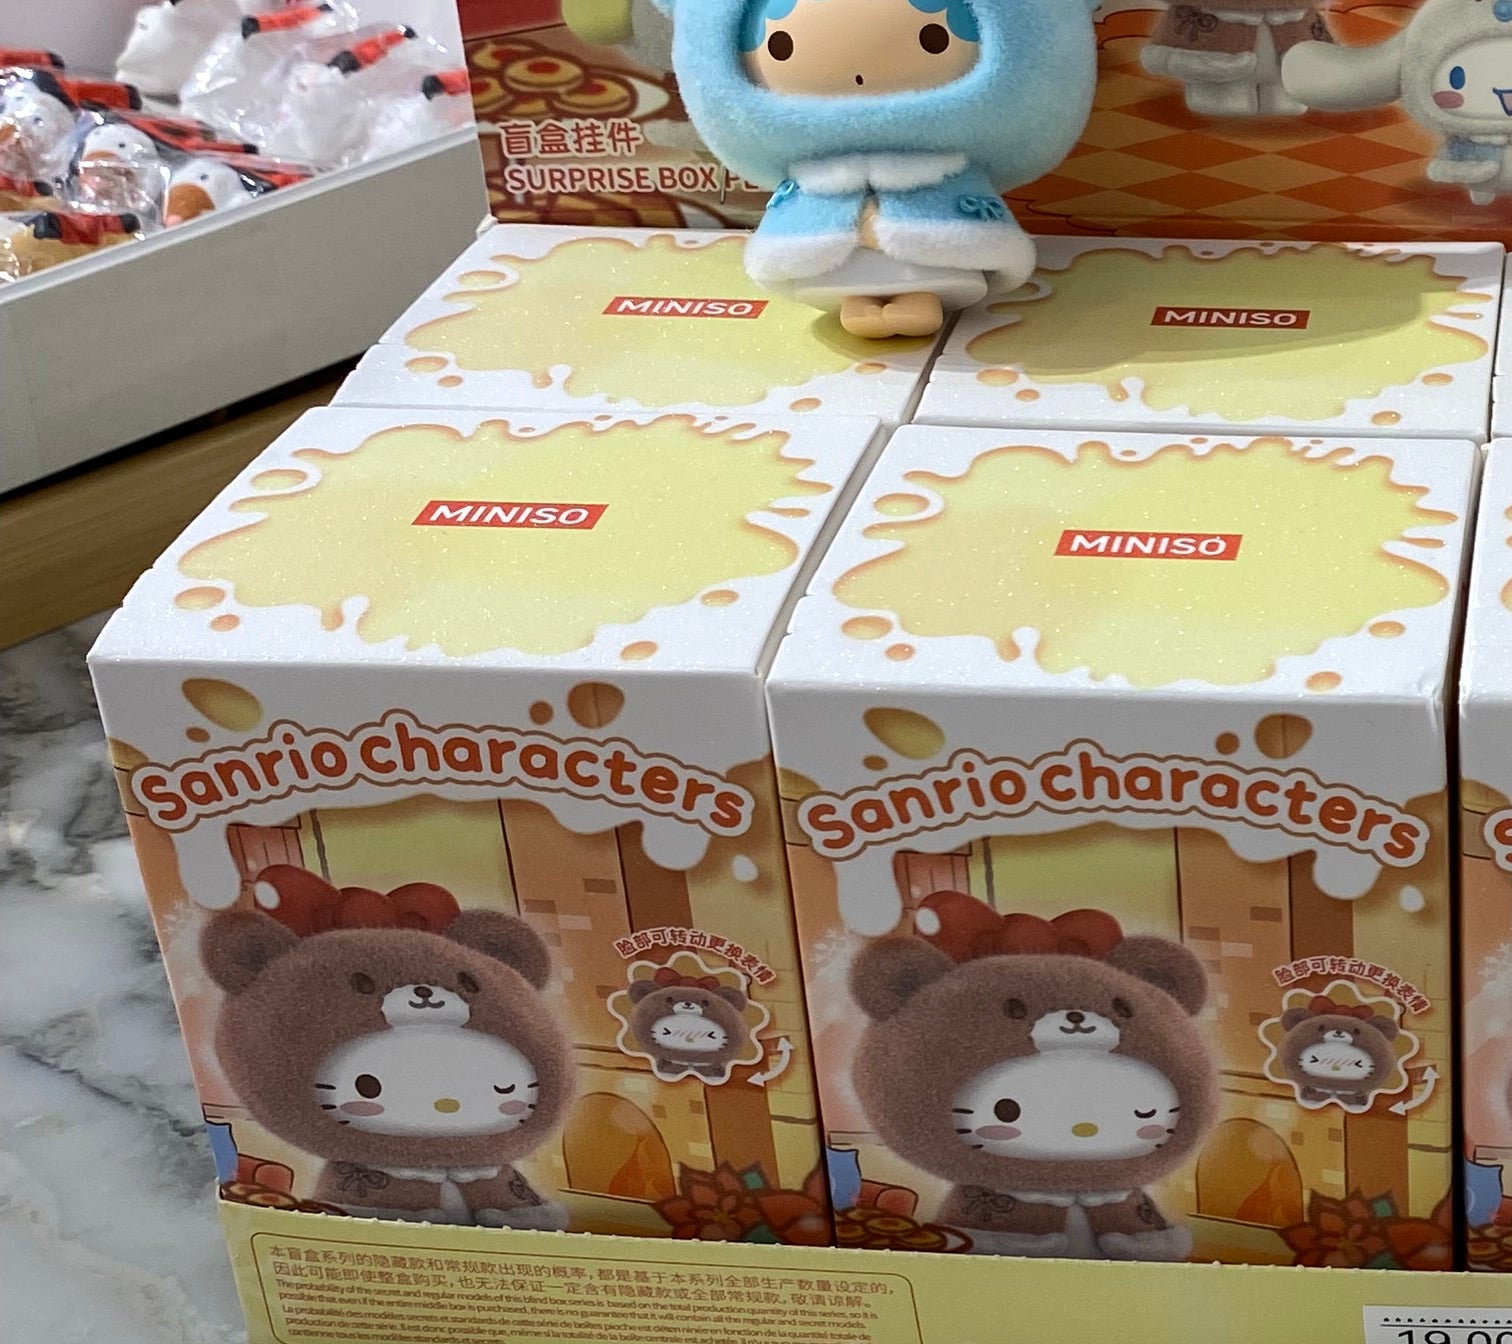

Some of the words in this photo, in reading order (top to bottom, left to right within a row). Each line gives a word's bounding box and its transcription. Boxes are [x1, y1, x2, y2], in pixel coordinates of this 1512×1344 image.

[502, 122, 641, 155] 盲盒挂件
[506, 167, 652, 192] SURPRISE
[659, 167, 719, 191] BOX
[615, 299, 755, 317] MINISO
[1162, 309, 1299, 327] MINISO
[427, 504, 590, 526] MINISO
[1069, 533, 1227, 557] MINISO
[141, 733, 346, 821] Sanrio
[360, 722, 746, 829] characters
[808, 761, 1027, 850] Sanrio
[1040, 751, 1421, 859] characters
[615, 928, 776, 984] 脸部可转动更换表情
[1274, 956, 1431, 1014] 脸部可转动更换表情
